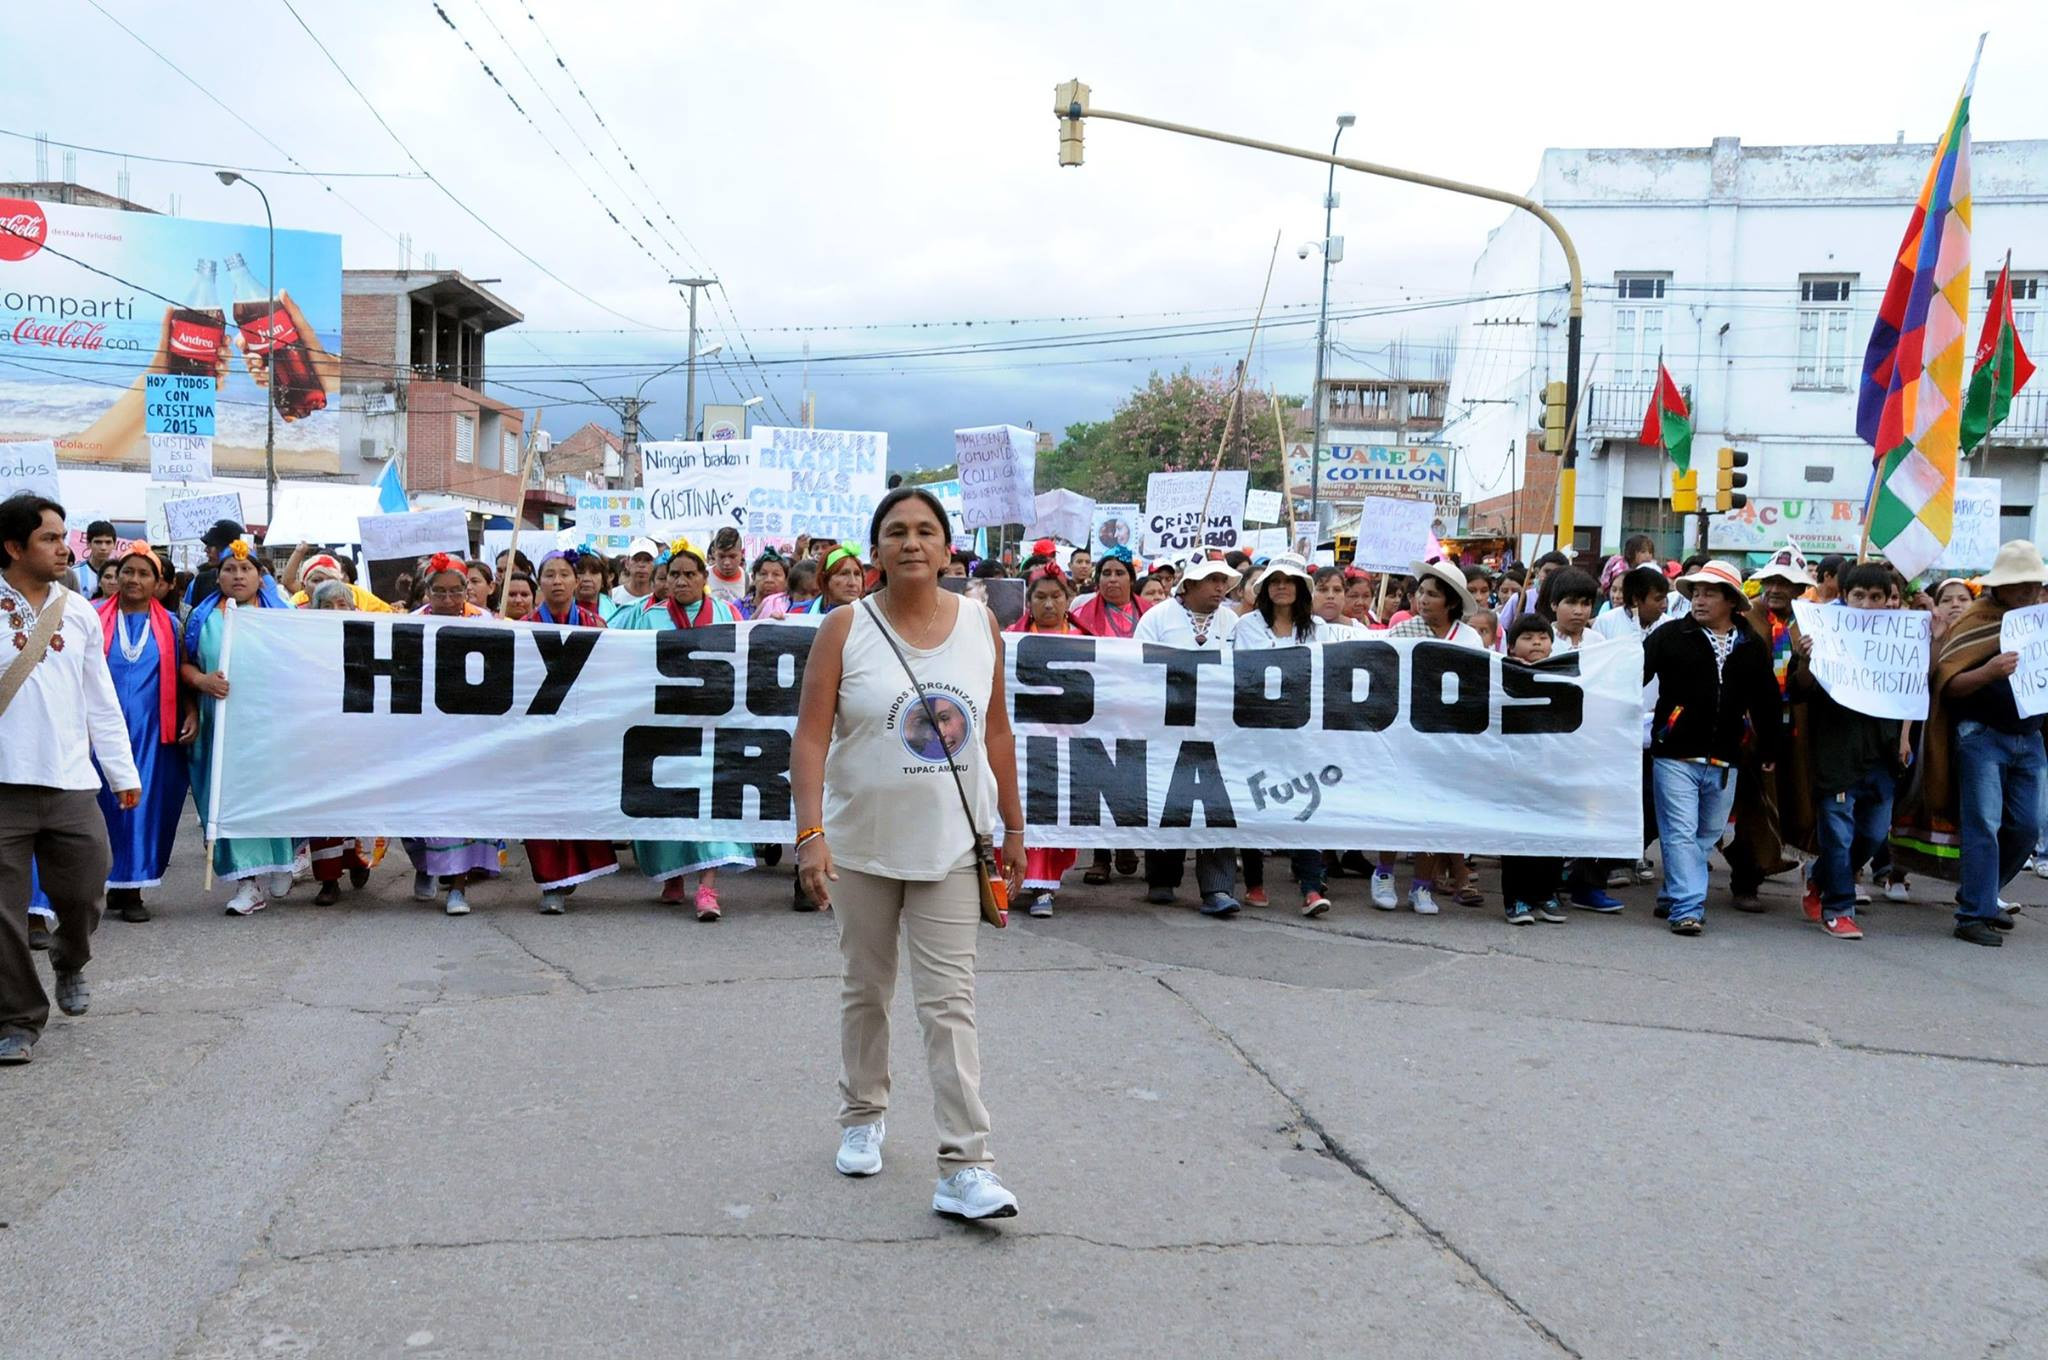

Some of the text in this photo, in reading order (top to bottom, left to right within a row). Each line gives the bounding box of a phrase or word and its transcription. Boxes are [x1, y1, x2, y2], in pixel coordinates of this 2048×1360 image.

[51, 229, 123, 241] destapa felicidad
[0, 288, 134, 320] ompartí
[106, 338, 140, 351] con
[178, 332, 214, 349] Andrea
[147, 376, 210, 390] HOY TODOS
[165, 390, 190, 402] CON
[147, 404, 215, 418] CRISTINA
[163, 418, 198, 434] 2015
[152, 436, 206, 450] CRISTINA
[170, 451, 182, 460] ES
[645, 448, 696, 474] Ningún
[1289, 444, 1446, 466] ACUARELA
[1326, 465, 1446, 483] COTILLÓN
[609, 515, 632, 528] ES
[748, 511, 784, 533] ES
[1831, 610, 1928, 640] JOVENES
[1863, 639, 1921, 670] PUNA
[342, 620, 1584, 735] HOY SOS TODOS
[886, 690, 910, 730] UNIDOS
[620, 725, 1237, 828] CRINA
[902, 765, 935, 775] TUPAC
